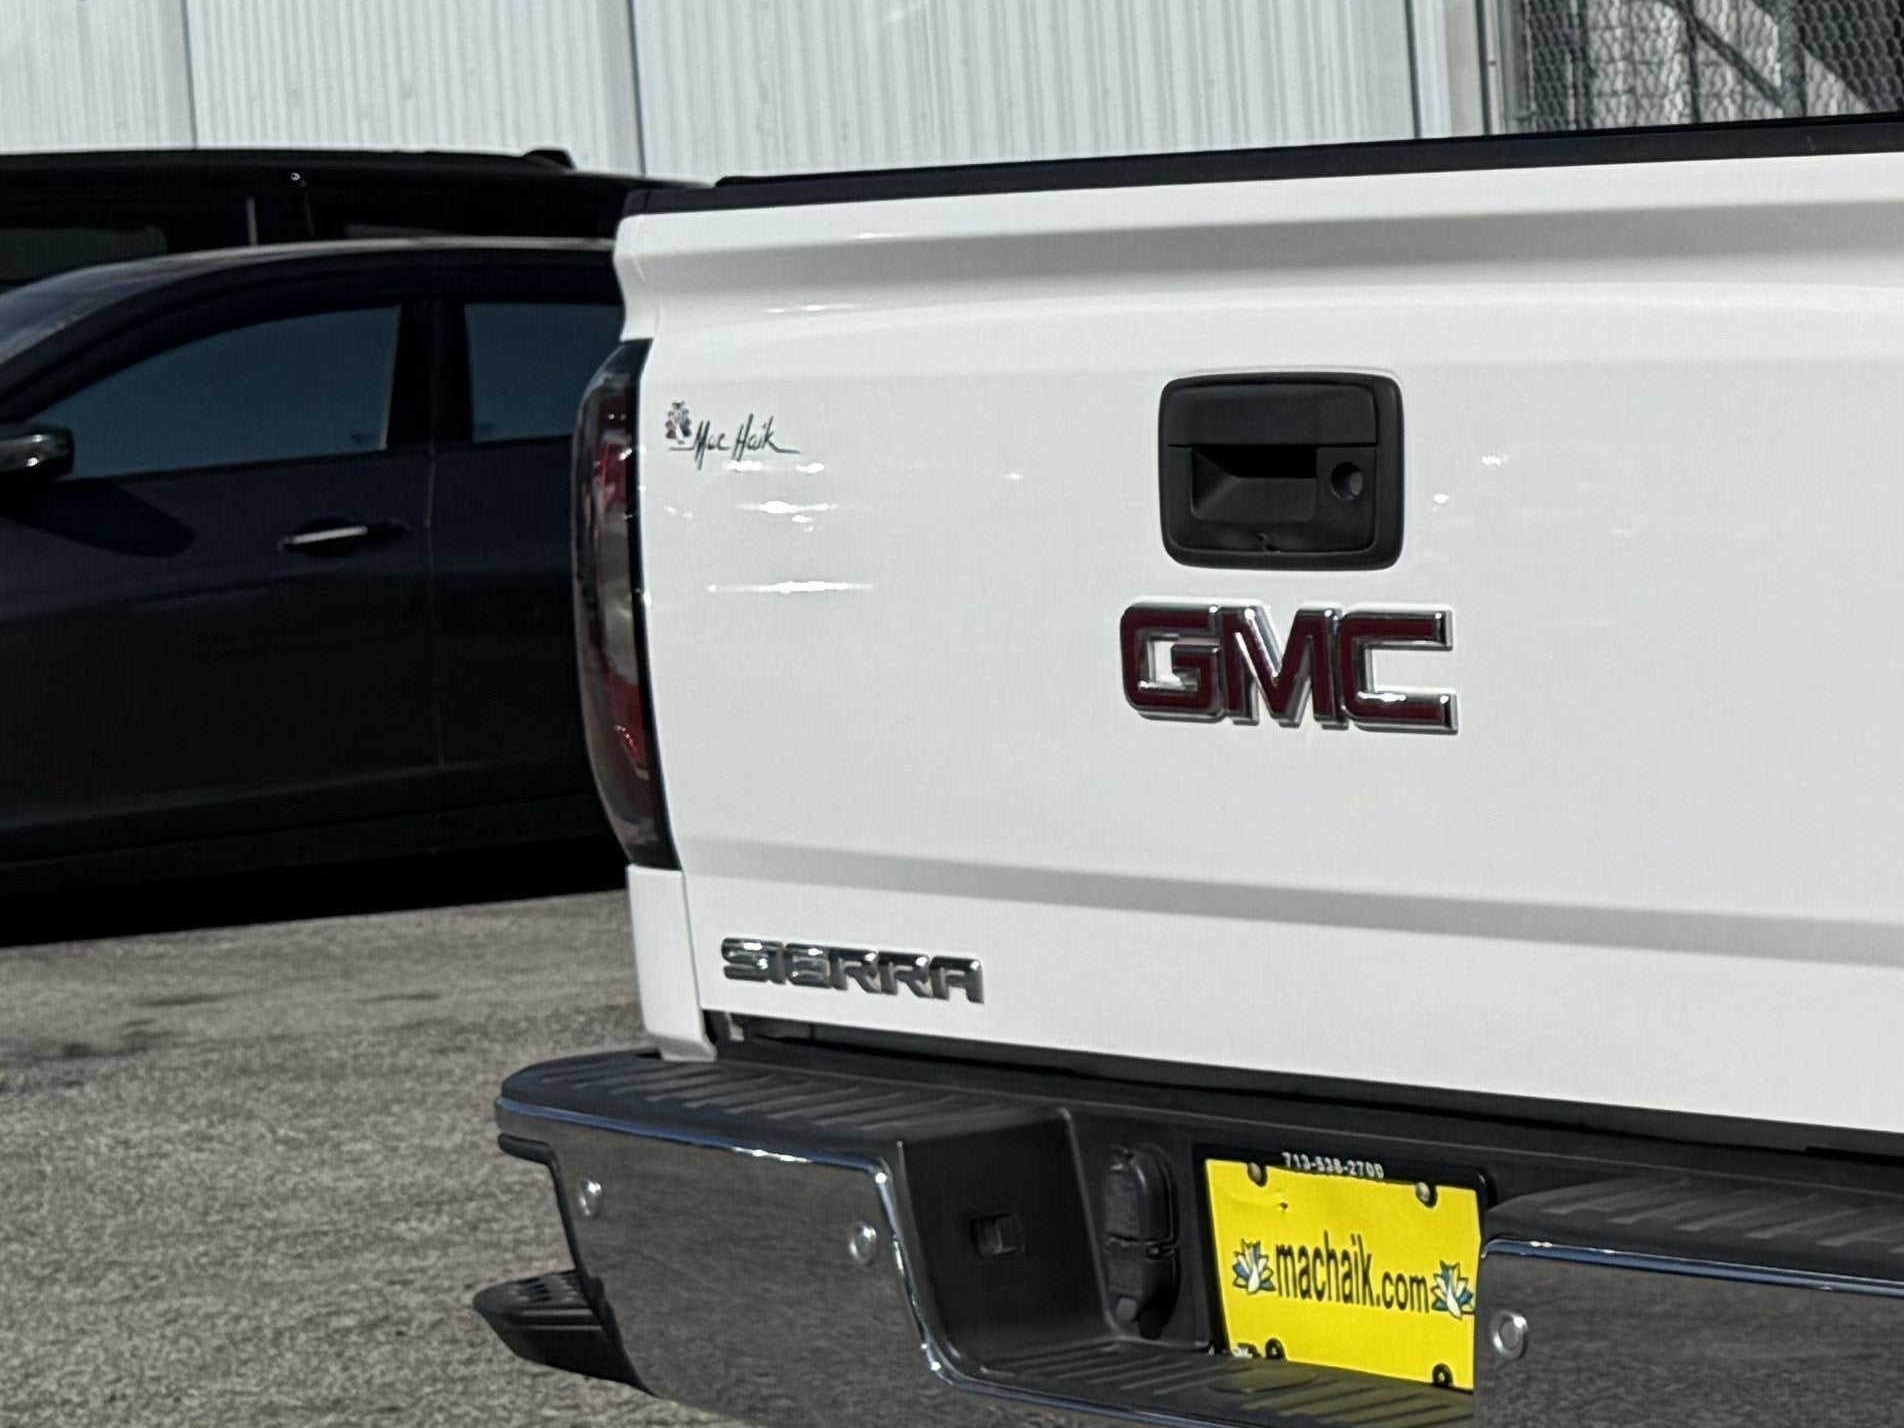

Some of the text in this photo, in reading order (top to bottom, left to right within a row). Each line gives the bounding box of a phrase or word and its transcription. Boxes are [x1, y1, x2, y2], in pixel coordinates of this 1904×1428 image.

[1120, 597, 1459, 734] GMC
[721, 936, 985, 1005] SIERRA
[1275, 1230, 1430, 1313] machaik.com
